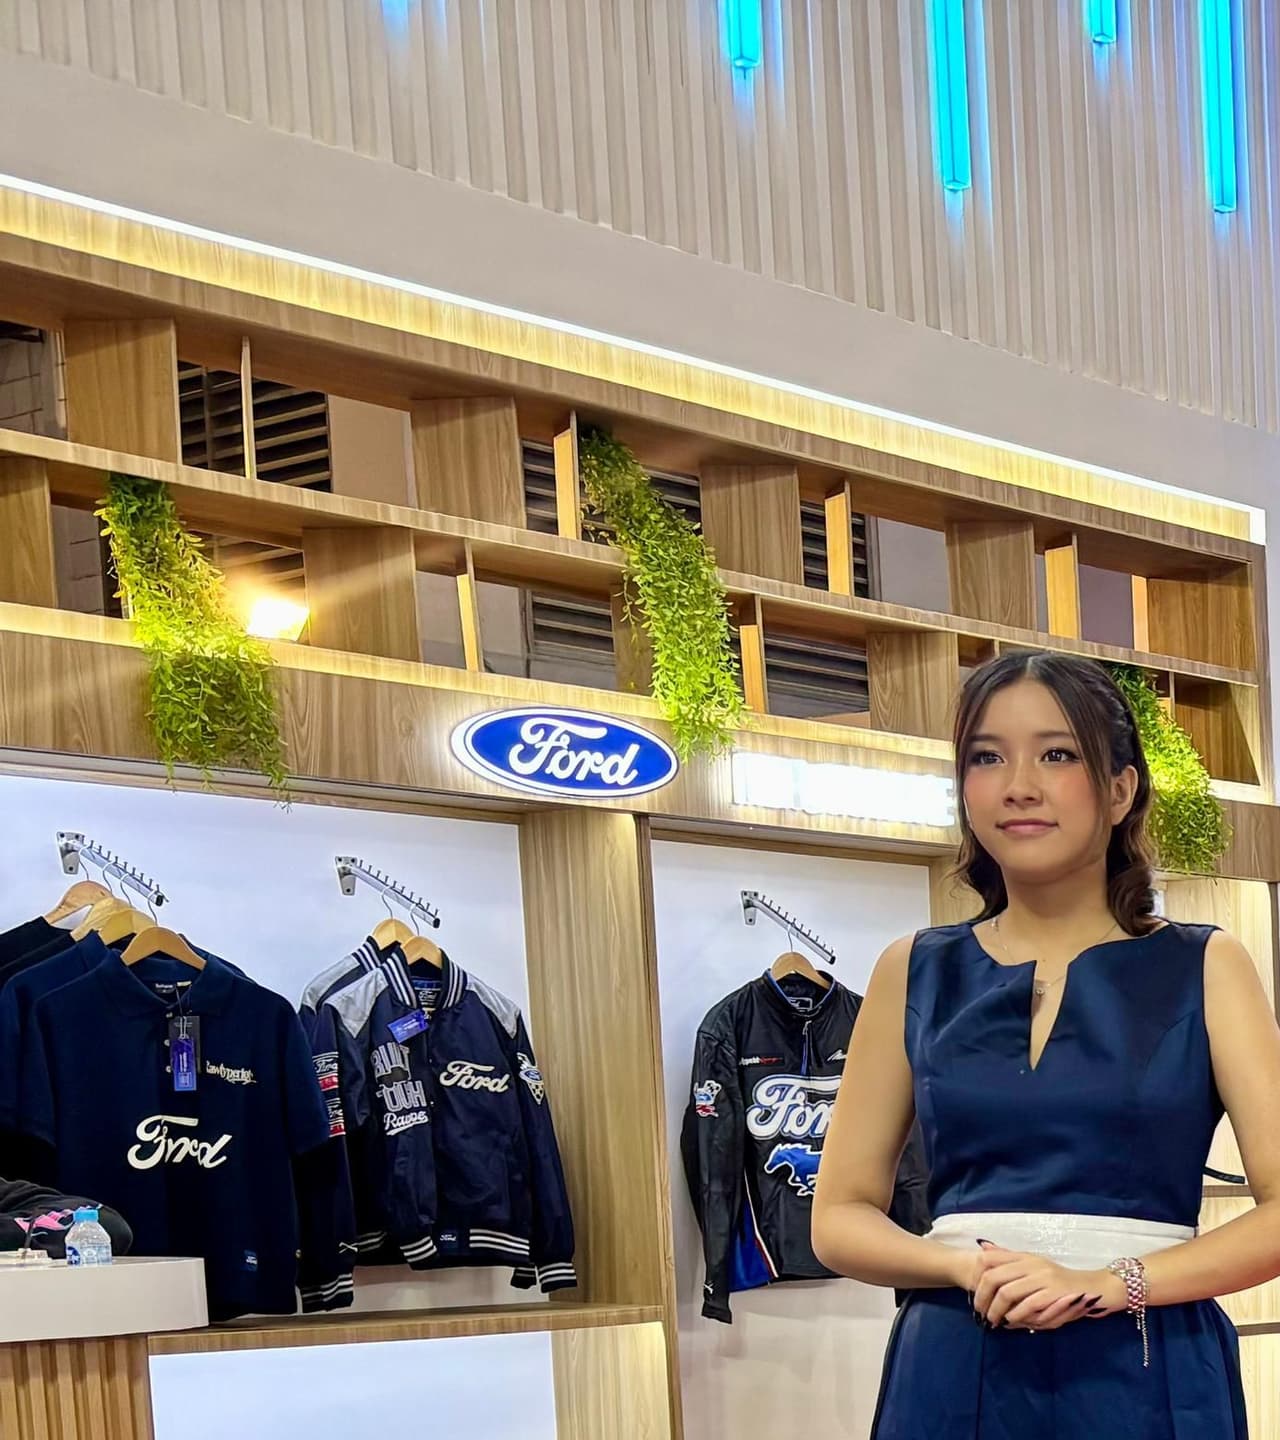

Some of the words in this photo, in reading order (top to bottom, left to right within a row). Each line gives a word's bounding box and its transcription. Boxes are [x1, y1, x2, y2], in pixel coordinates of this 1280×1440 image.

[508, 717, 640, 786] Ford
[439, 1060, 511, 1093] Ford
[745, 1074, 841, 1140] For
